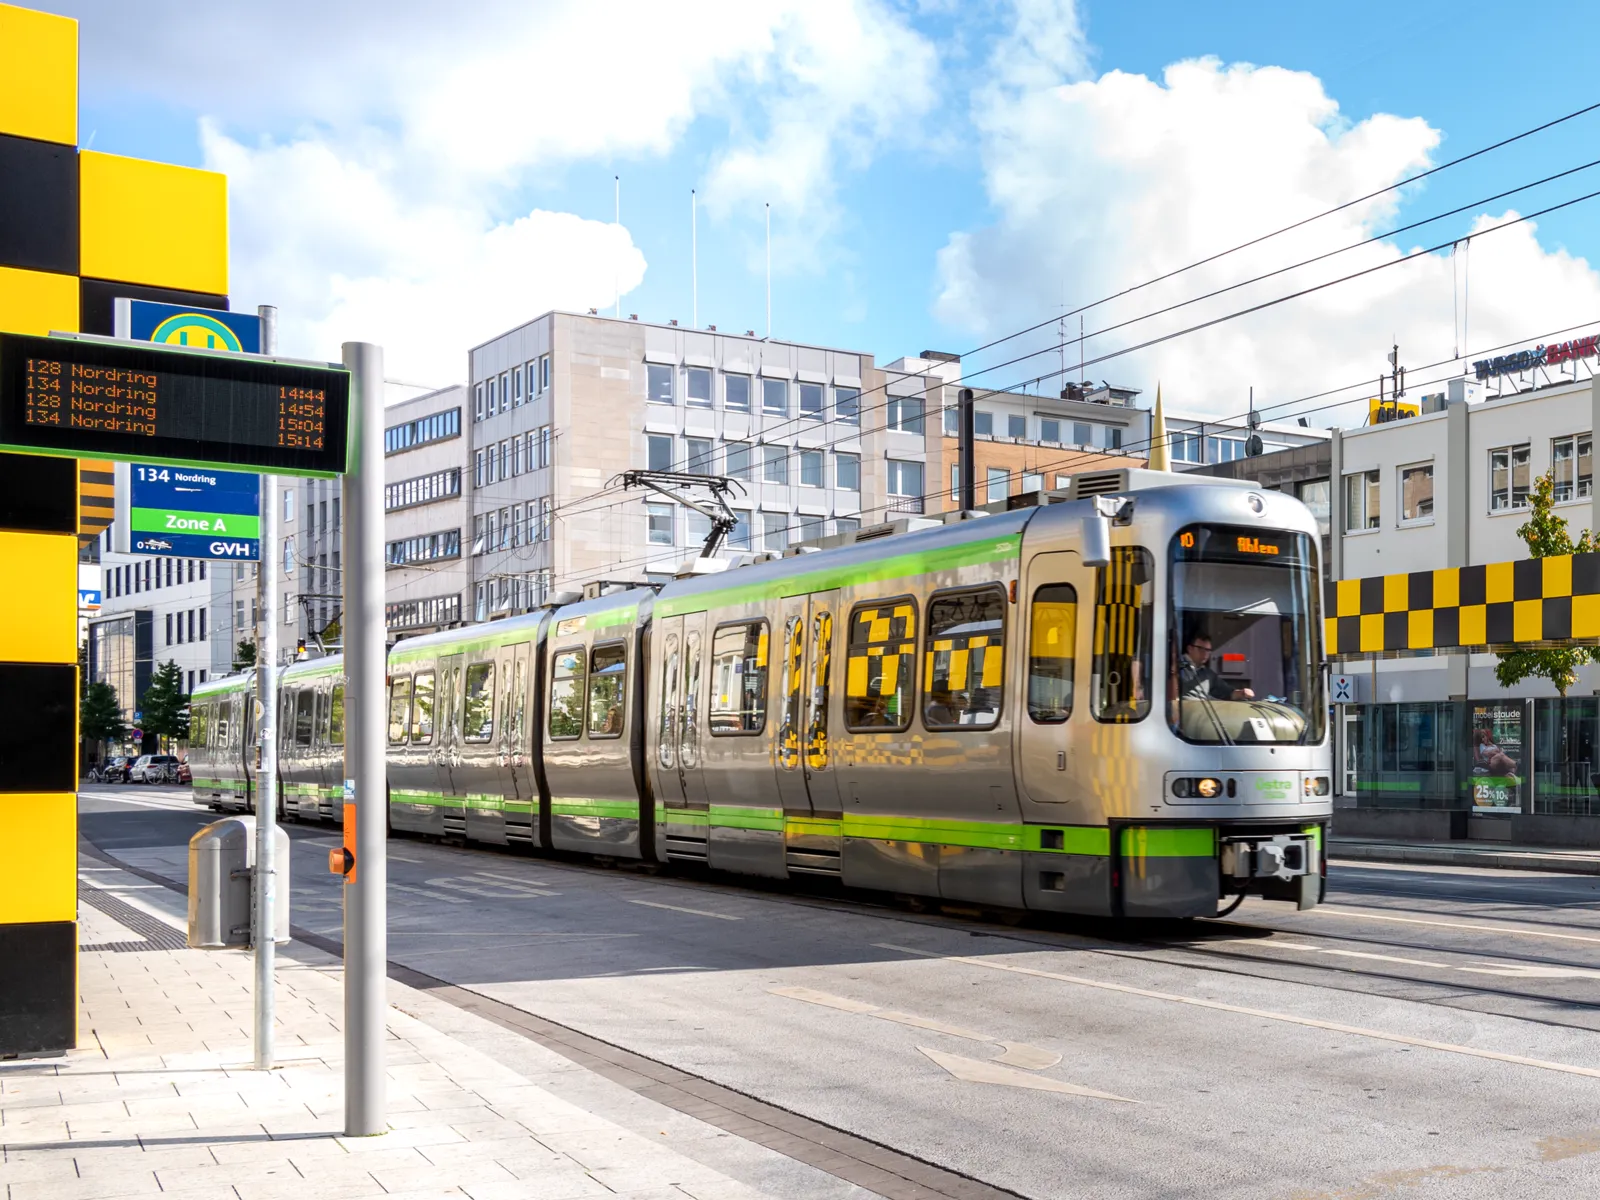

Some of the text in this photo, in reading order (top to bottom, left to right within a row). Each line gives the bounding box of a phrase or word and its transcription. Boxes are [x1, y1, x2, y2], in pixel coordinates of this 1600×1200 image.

[1547, 334, 1600, 365] BANK
[27, 359, 325, 402] 128 Nordring 14:44
[27, 376, 325, 418] 134 Nordring 14:54
[27, 392, 324, 433] 128 Nordring 15:04
[26, 409, 323, 448] 134 Nordring 15:14
[137, 467, 217, 486] 134 Nordring
[165, 514, 227, 532] Zone A
[209, 541, 250, 557] GVH
[1493, 710, 1521, 719] staude
